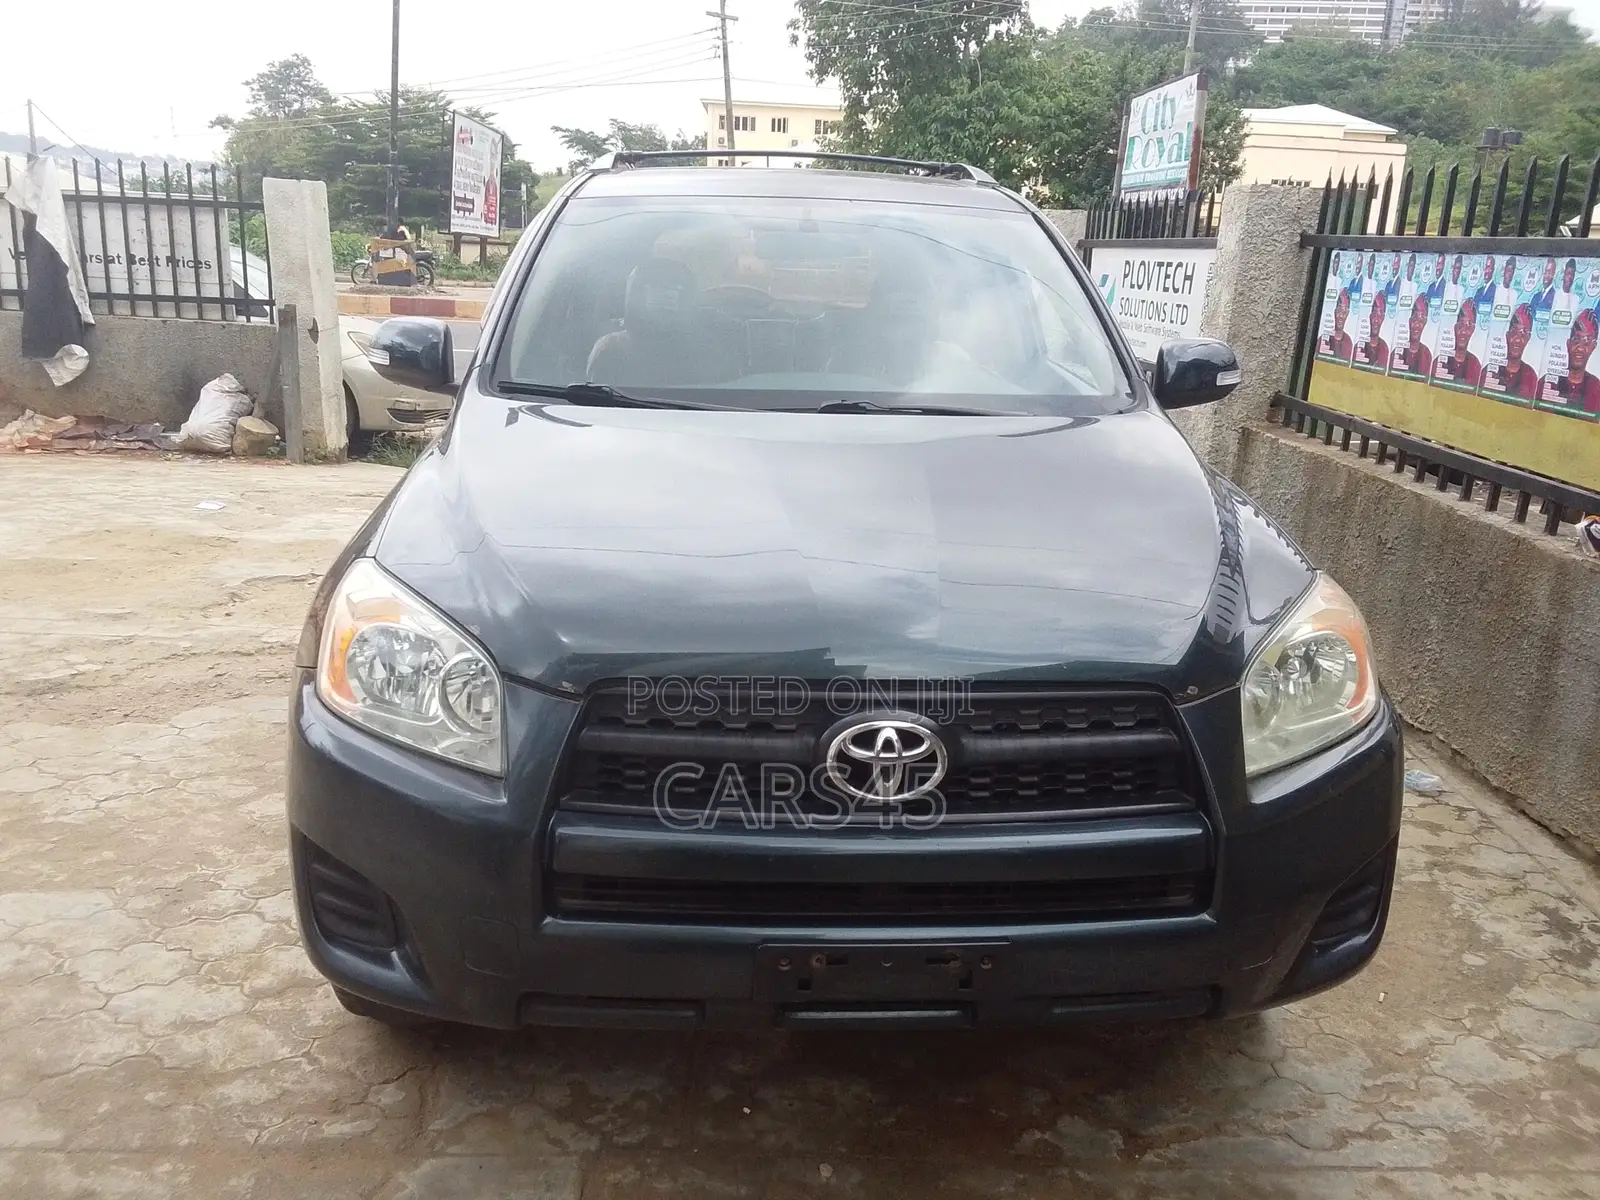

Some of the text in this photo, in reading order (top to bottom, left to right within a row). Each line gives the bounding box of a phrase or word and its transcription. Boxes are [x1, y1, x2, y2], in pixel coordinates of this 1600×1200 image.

[1141, 91, 1182, 135] City
[1124, 121, 1192, 170] Royal
[107, 253, 122, 265] at
[1122, 260, 1196, 295] PLOVTECH
[1119, 297, 1189, 326] SOLUTIONS LTD
